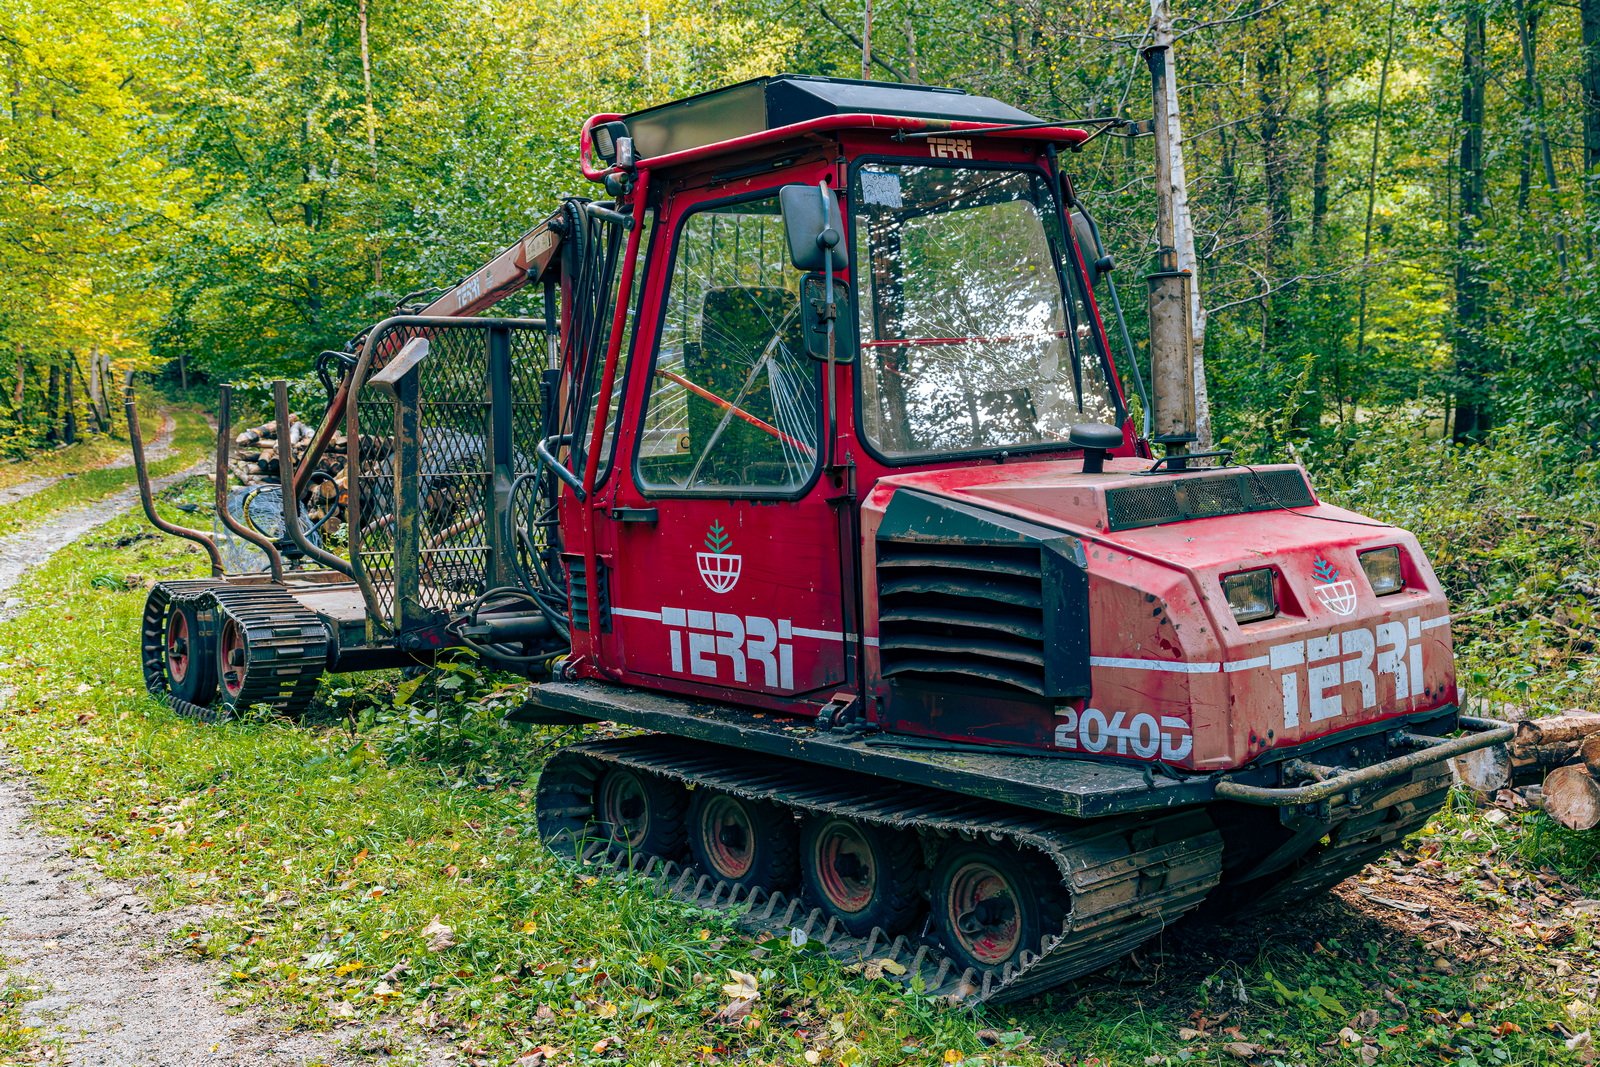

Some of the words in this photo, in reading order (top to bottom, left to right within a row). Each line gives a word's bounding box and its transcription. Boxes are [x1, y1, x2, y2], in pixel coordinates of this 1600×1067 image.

[927, 137, 973, 159] TERRI
[661, 606, 794, 690] TERRI
[1269, 615, 1425, 729] TERRI
[1054, 705, 1193, 761] 2040D
